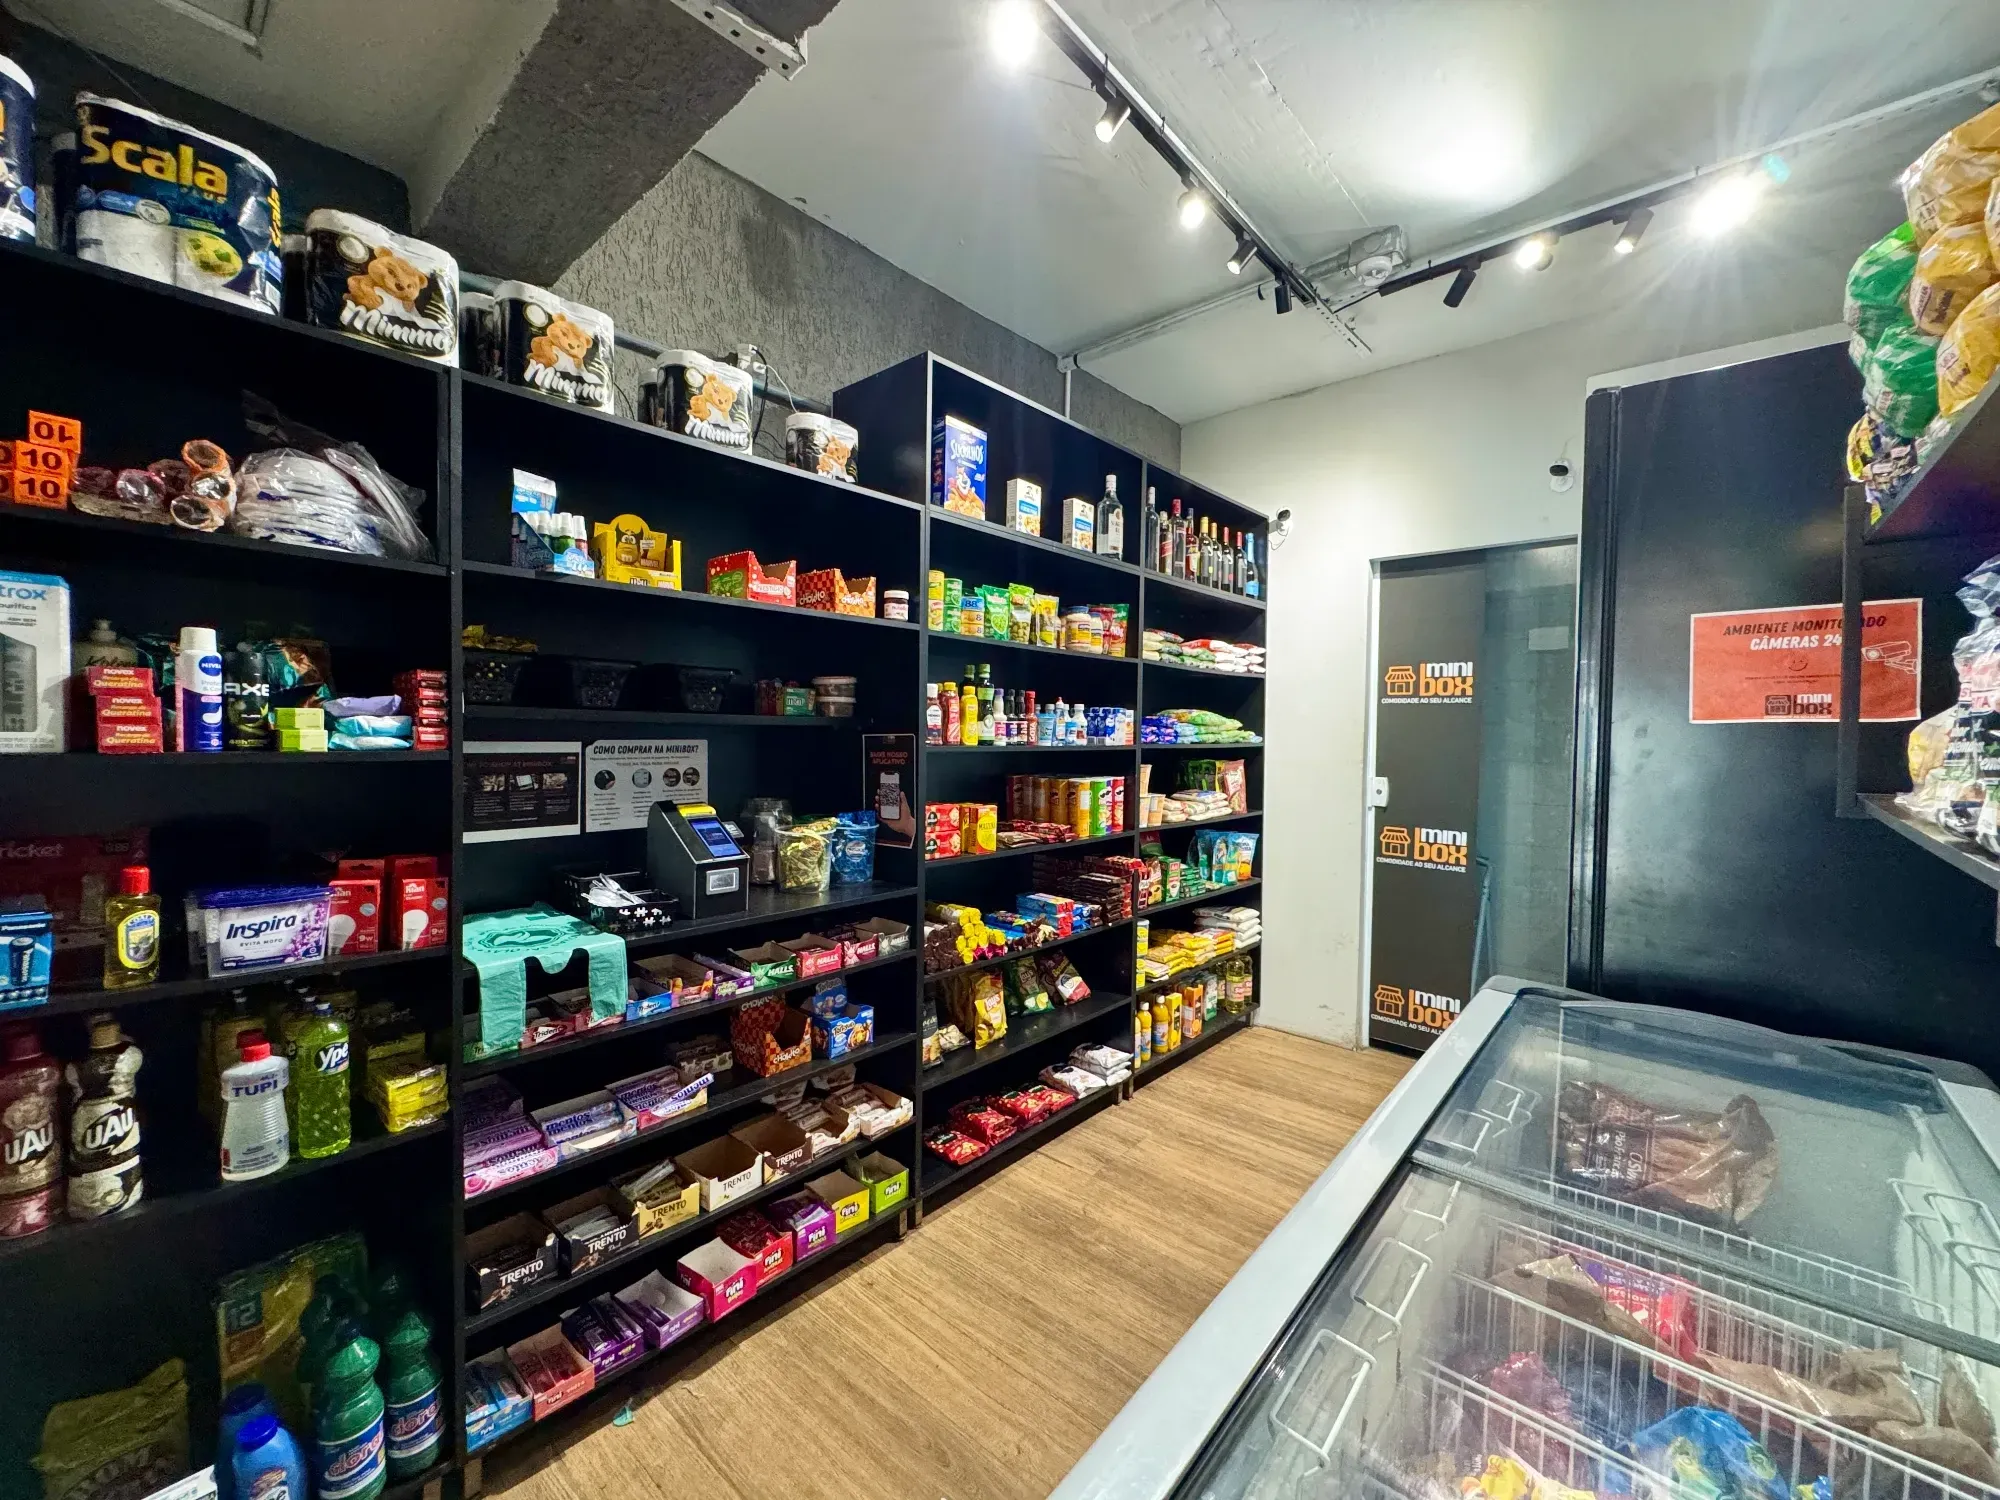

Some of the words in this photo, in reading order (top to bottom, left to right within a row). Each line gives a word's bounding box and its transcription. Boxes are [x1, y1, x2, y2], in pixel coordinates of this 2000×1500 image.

[80, 124, 227, 196] Scala
[523, 359, 605, 401] Mimmo
[21, 448, 62, 470] 10
[19, 477, 61, 500] 10
[1723, 621, 1789, 636] AMBIENTE
[1792, 615, 1887, 632] MONITODO
[1751, 634, 1819, 650] CÂMERAS
[103, 668, 135, 676] novex
[1426, 661, 1473, 677] mini
[93, 680, 145, 688] Queratina
[1420, 663, 1473, 696] box
[223, 683, 270, 697] AXE
[1797, 693, 1833, 703] mini
[112, 696, 144, 704] novex
[1793, 694, 1833, 715] box
[101, 709, 153, 718] Queratina
[105, 737, 156, 746] Queratina
[593, 745, 616, 754] COMO
[617, 745, 652, 754] COMPRAR
[654, 745, 664, 753] NA
[666, 744, 699, 753] MINIBOX?
[1421, 827, 1467, 846] mini
[1414, 827, 1467, 865] box
[1376, 857, 1413, 867] COMODIDADE
[1424, 862, 1436, 870] SEU
[1437, 864, 1466, 873] ALCANCE
[1, 923, 46, 931] Panasonic
[226, 914, 297, 940] Inspira
[239, 939, 262, 947] EVITA
[857, 943, 876, 955] HALLS
[817, 954, 839, 966] HALLS
[768, 964, 794, 977] HALLS
[1415, 990, 1460, 1013] mini
[1370, 1014, 1408, 1028] COMODIDADE
[1409, 1022, 1417, 1030] AO
[1418, 1024, 1430, 1033] SEU
[232, 1079, 278, 1097] TUPI
[85, 1107, 134, 1148] UAU
[545, 1111, 591, 1129] mentos
[4, 1123, 54, 1165] UAU
[775, 1148, 803, 1168] TRENTO
[723, 1171, 751, 1191] TRENTO
[651, 1199, 687, 1220] TRENTO
[587, 1229, 627, 1254] TRENTO
[808, 1227, 826, 1243] Fini
[764, 1248, 783, 1266] Fini
[500, 1259, 544, 1287] TRENTO
[725, 1277, 745, 1298] Fini
